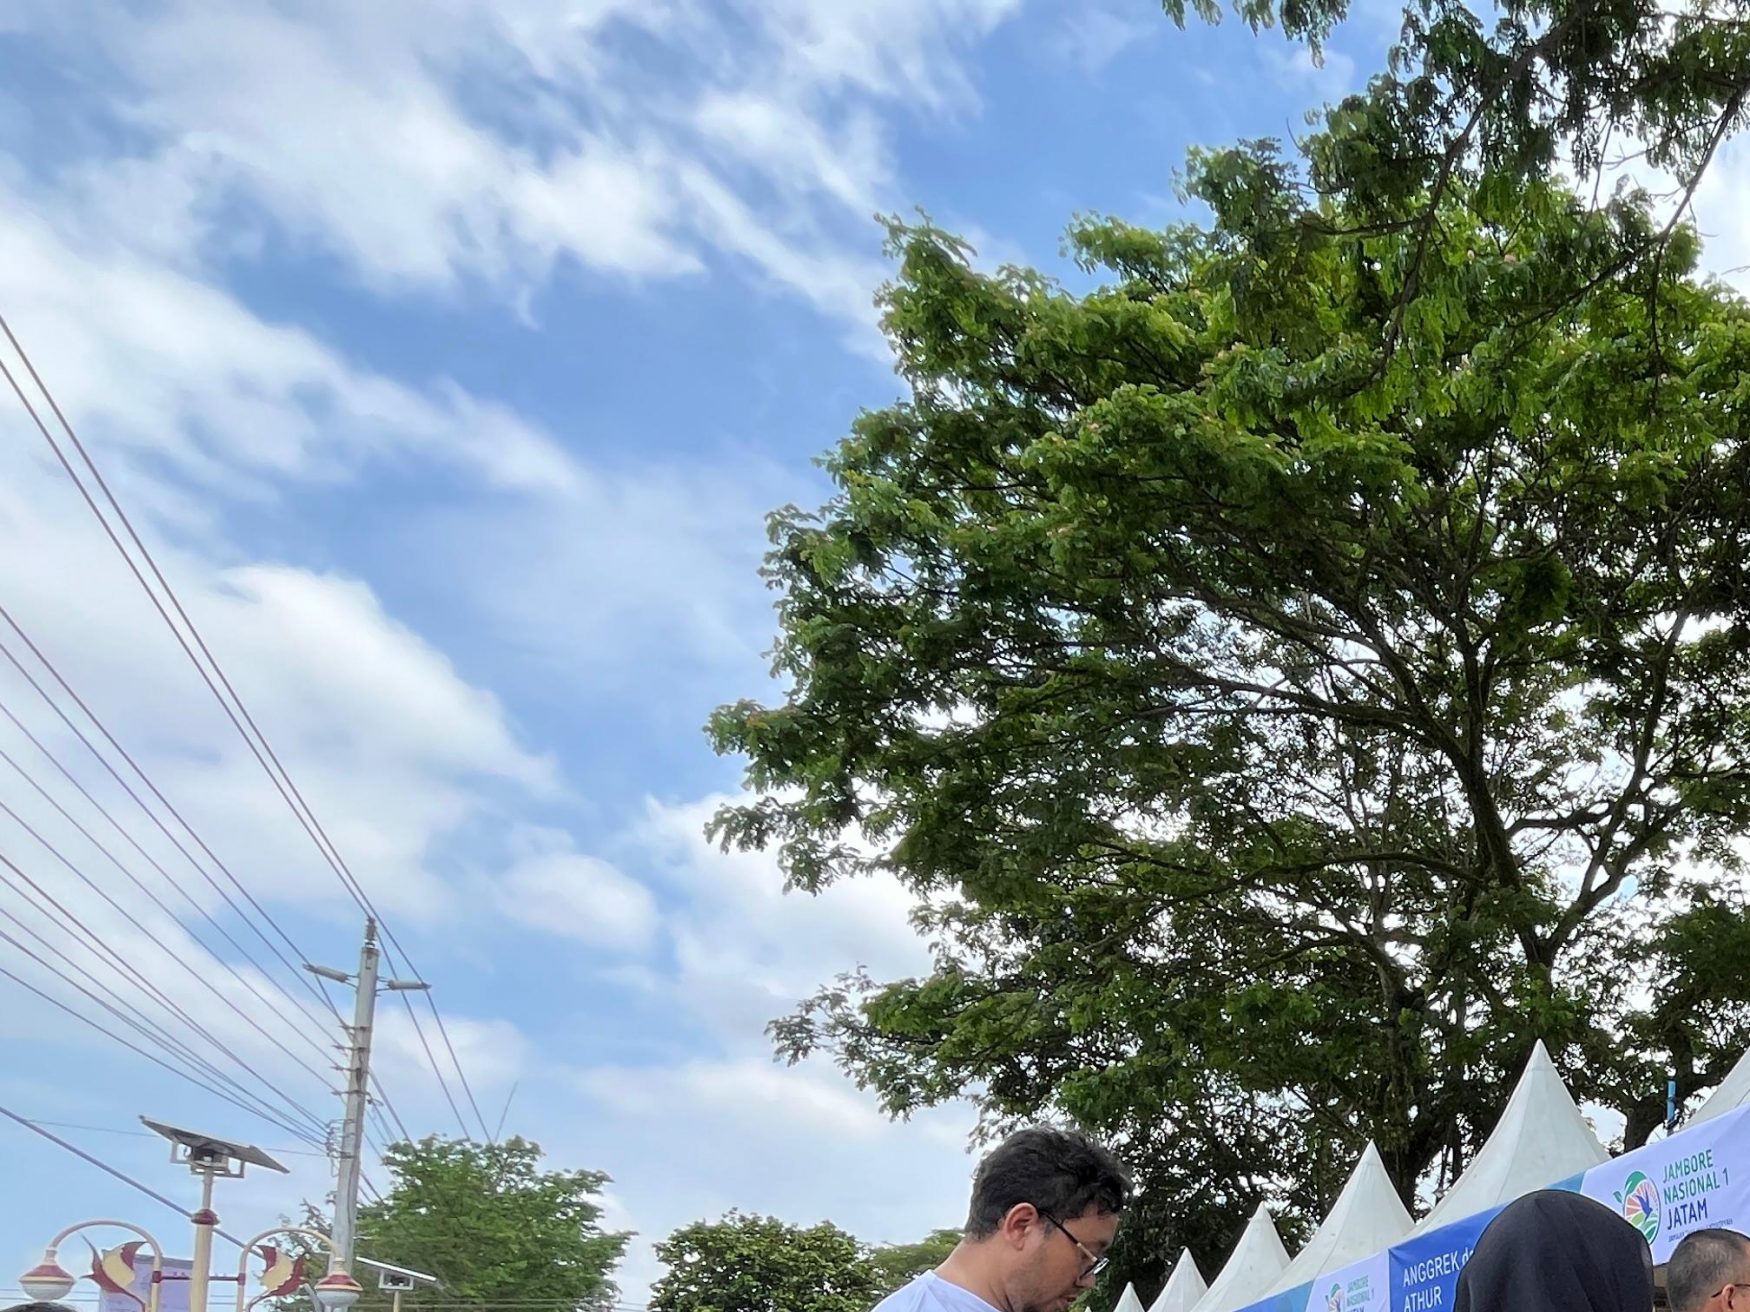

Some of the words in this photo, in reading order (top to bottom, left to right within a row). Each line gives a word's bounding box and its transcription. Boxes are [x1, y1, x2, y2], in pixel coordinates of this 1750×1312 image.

[1663, 1150, 1714, 1183] JAMBORE
[1663, 1172, 1720, 1205] NASIONAL
[1722, 1167, 1729, 1186] 1
[1667, 1198, 1708, 1230] JATAM
[1403, 1250, 1460, 1287] ANGGREK
